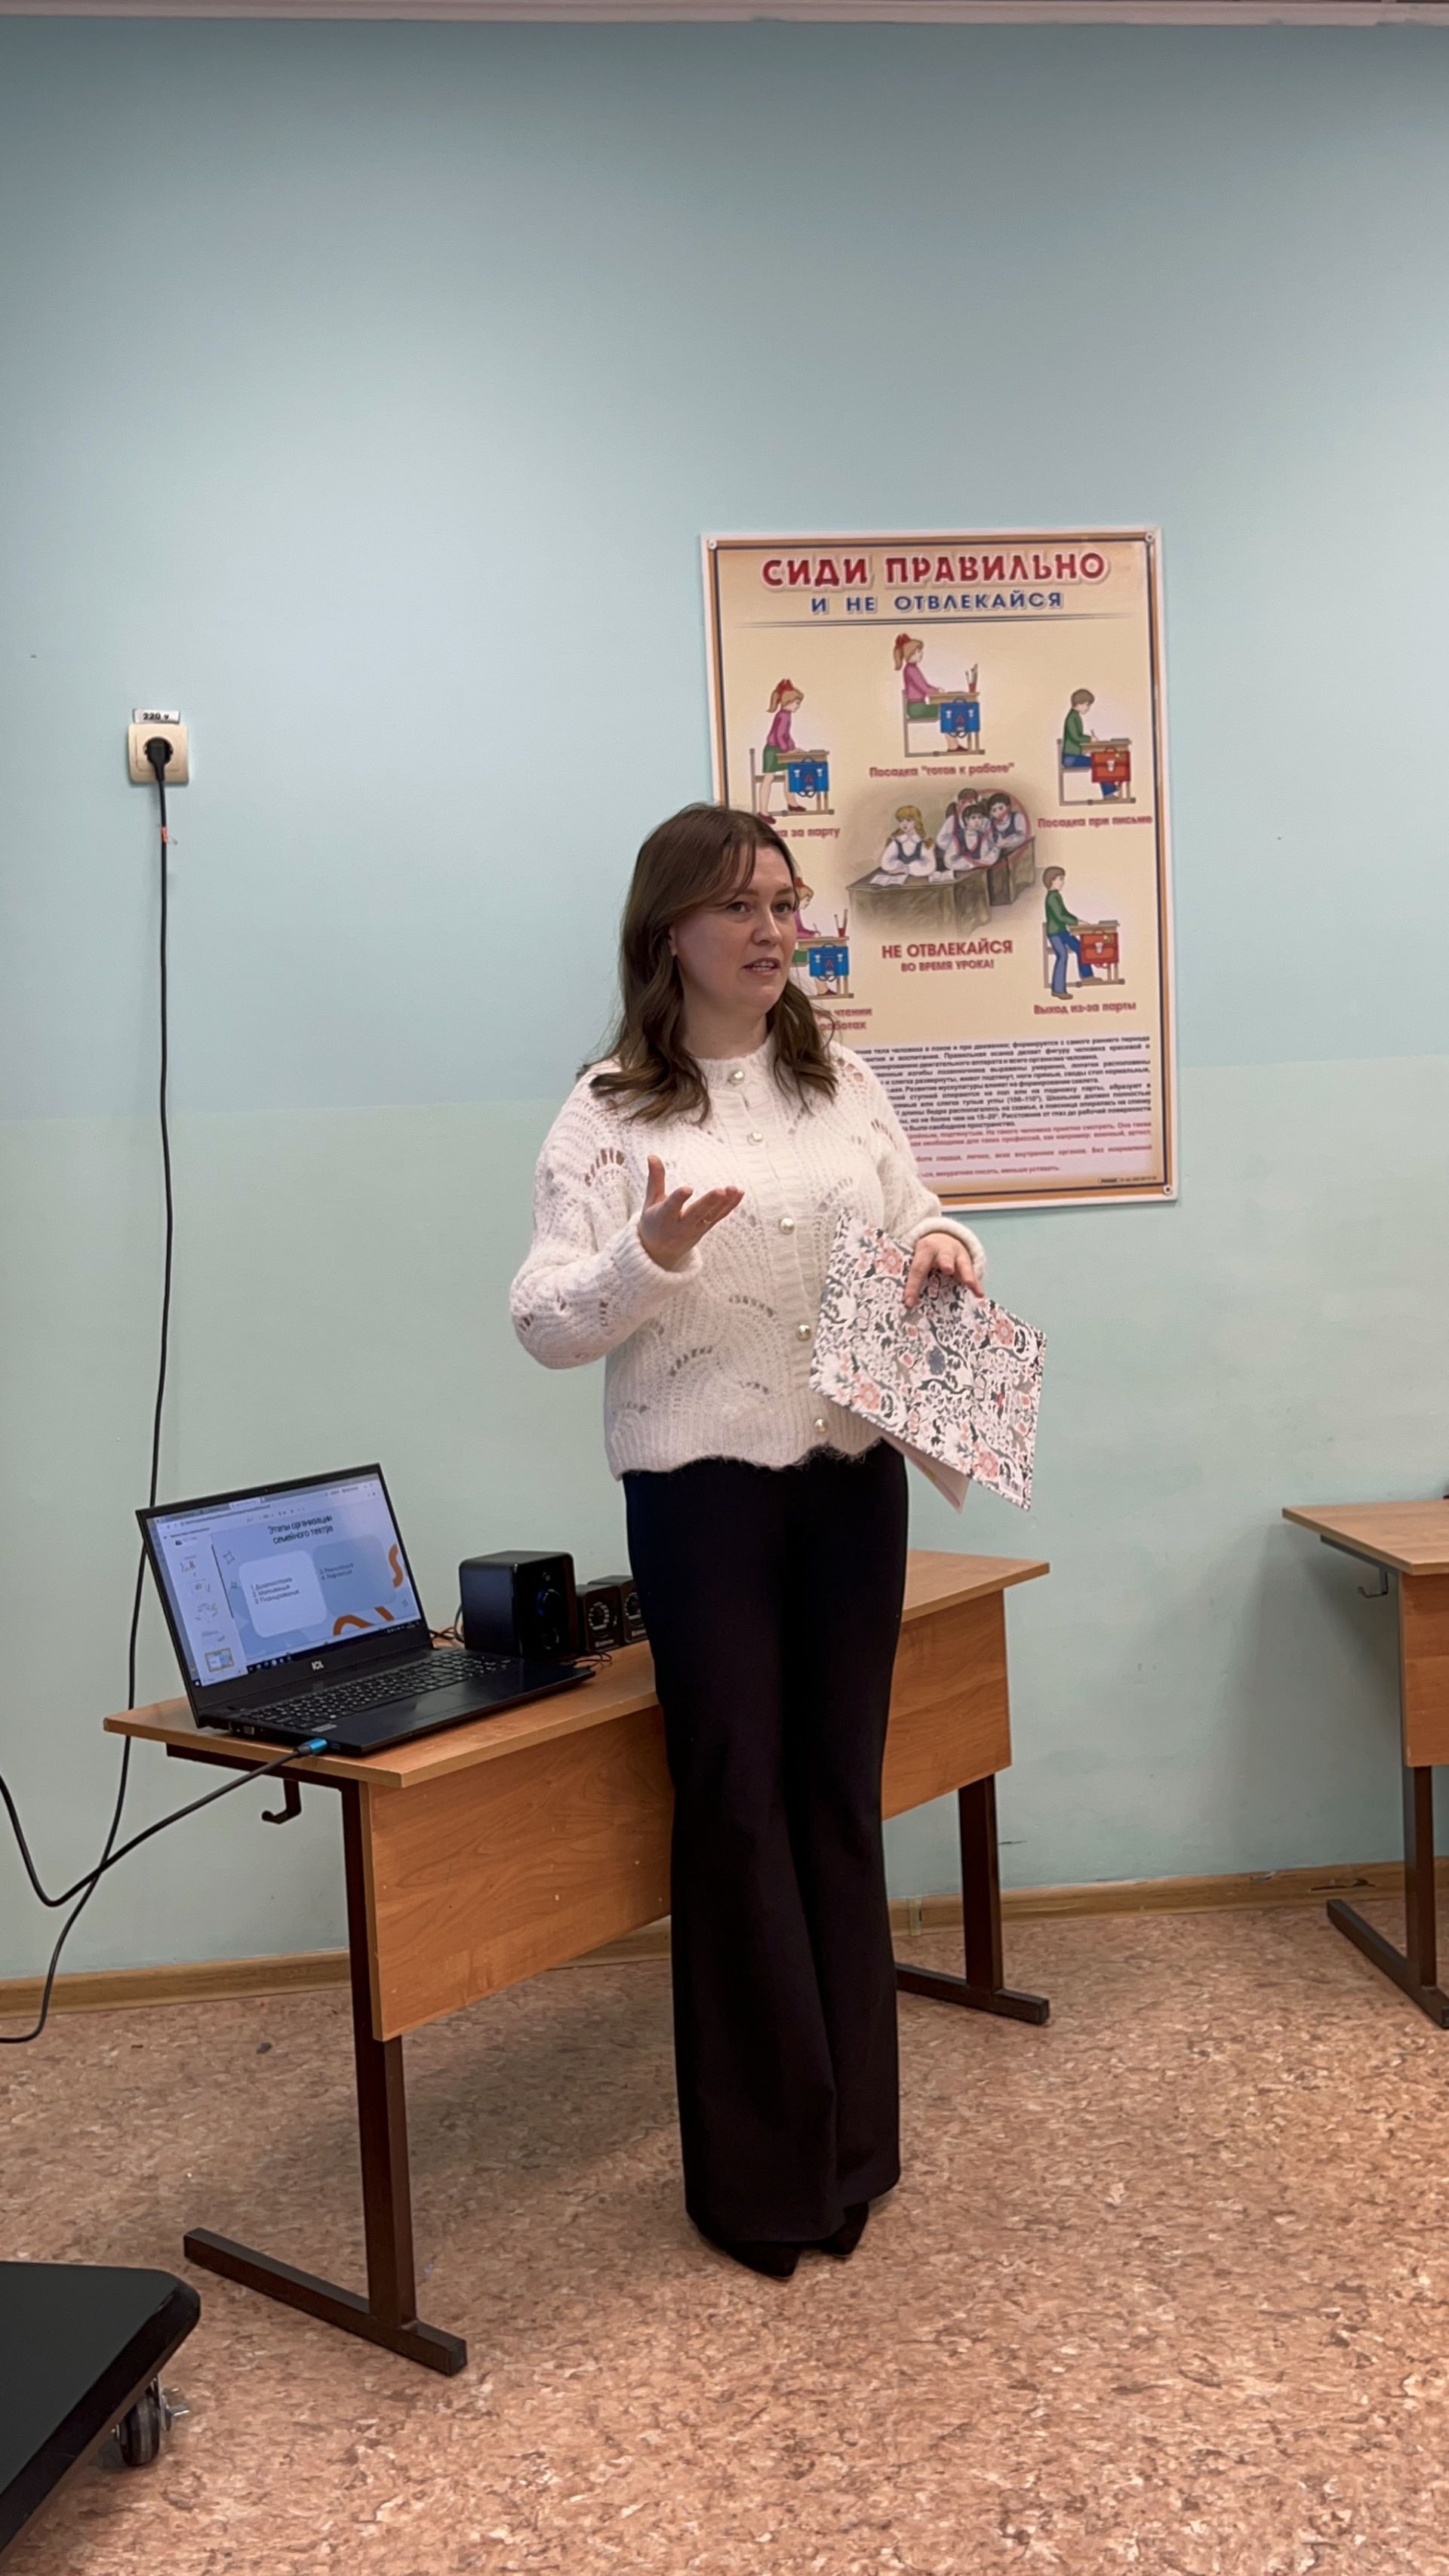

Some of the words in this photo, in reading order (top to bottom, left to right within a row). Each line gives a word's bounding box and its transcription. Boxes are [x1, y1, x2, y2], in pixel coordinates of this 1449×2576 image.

[761, 558, 869, 587] СИДИ
[884, 552, 1105, 583] ПРАВИЛЬНО
[811, 597, 827, 612] И
[846, 596, 875, 611] НЕ
[894, 590, 1062, 611] ОТВЛЕКАЙСЯ
[143, 712, 161, 721] 220
[869, 767, 918, 777] Посадка
[959, 766, 967, 774] к
[1038, 818, 1086, 829] Посадка
[1088, 817, 1109, 828] при
[1112, 816, 1152, 825] письме
[791, 829, 805, 838] за
[808, 828, 841, 839] парту
[881, 945, 903, 959] НЕ
[906, 937, 1013, 958] ОТВЛЕКАЙСЯ
[901, 962, 916, 972] ВО
[918, 961, 953, 971] ВРЕМЯ
[955, 959, 995, 970] УРОКА!
[1034, 1005, 1069, 1015] Выход
[1070, 1003, 1100, 1013] из-за
[1102, 1002, 1137, 1014] парты
[268, 1523, 291, 1534] Этапы
[310, 1525, 334, 1536] театра
